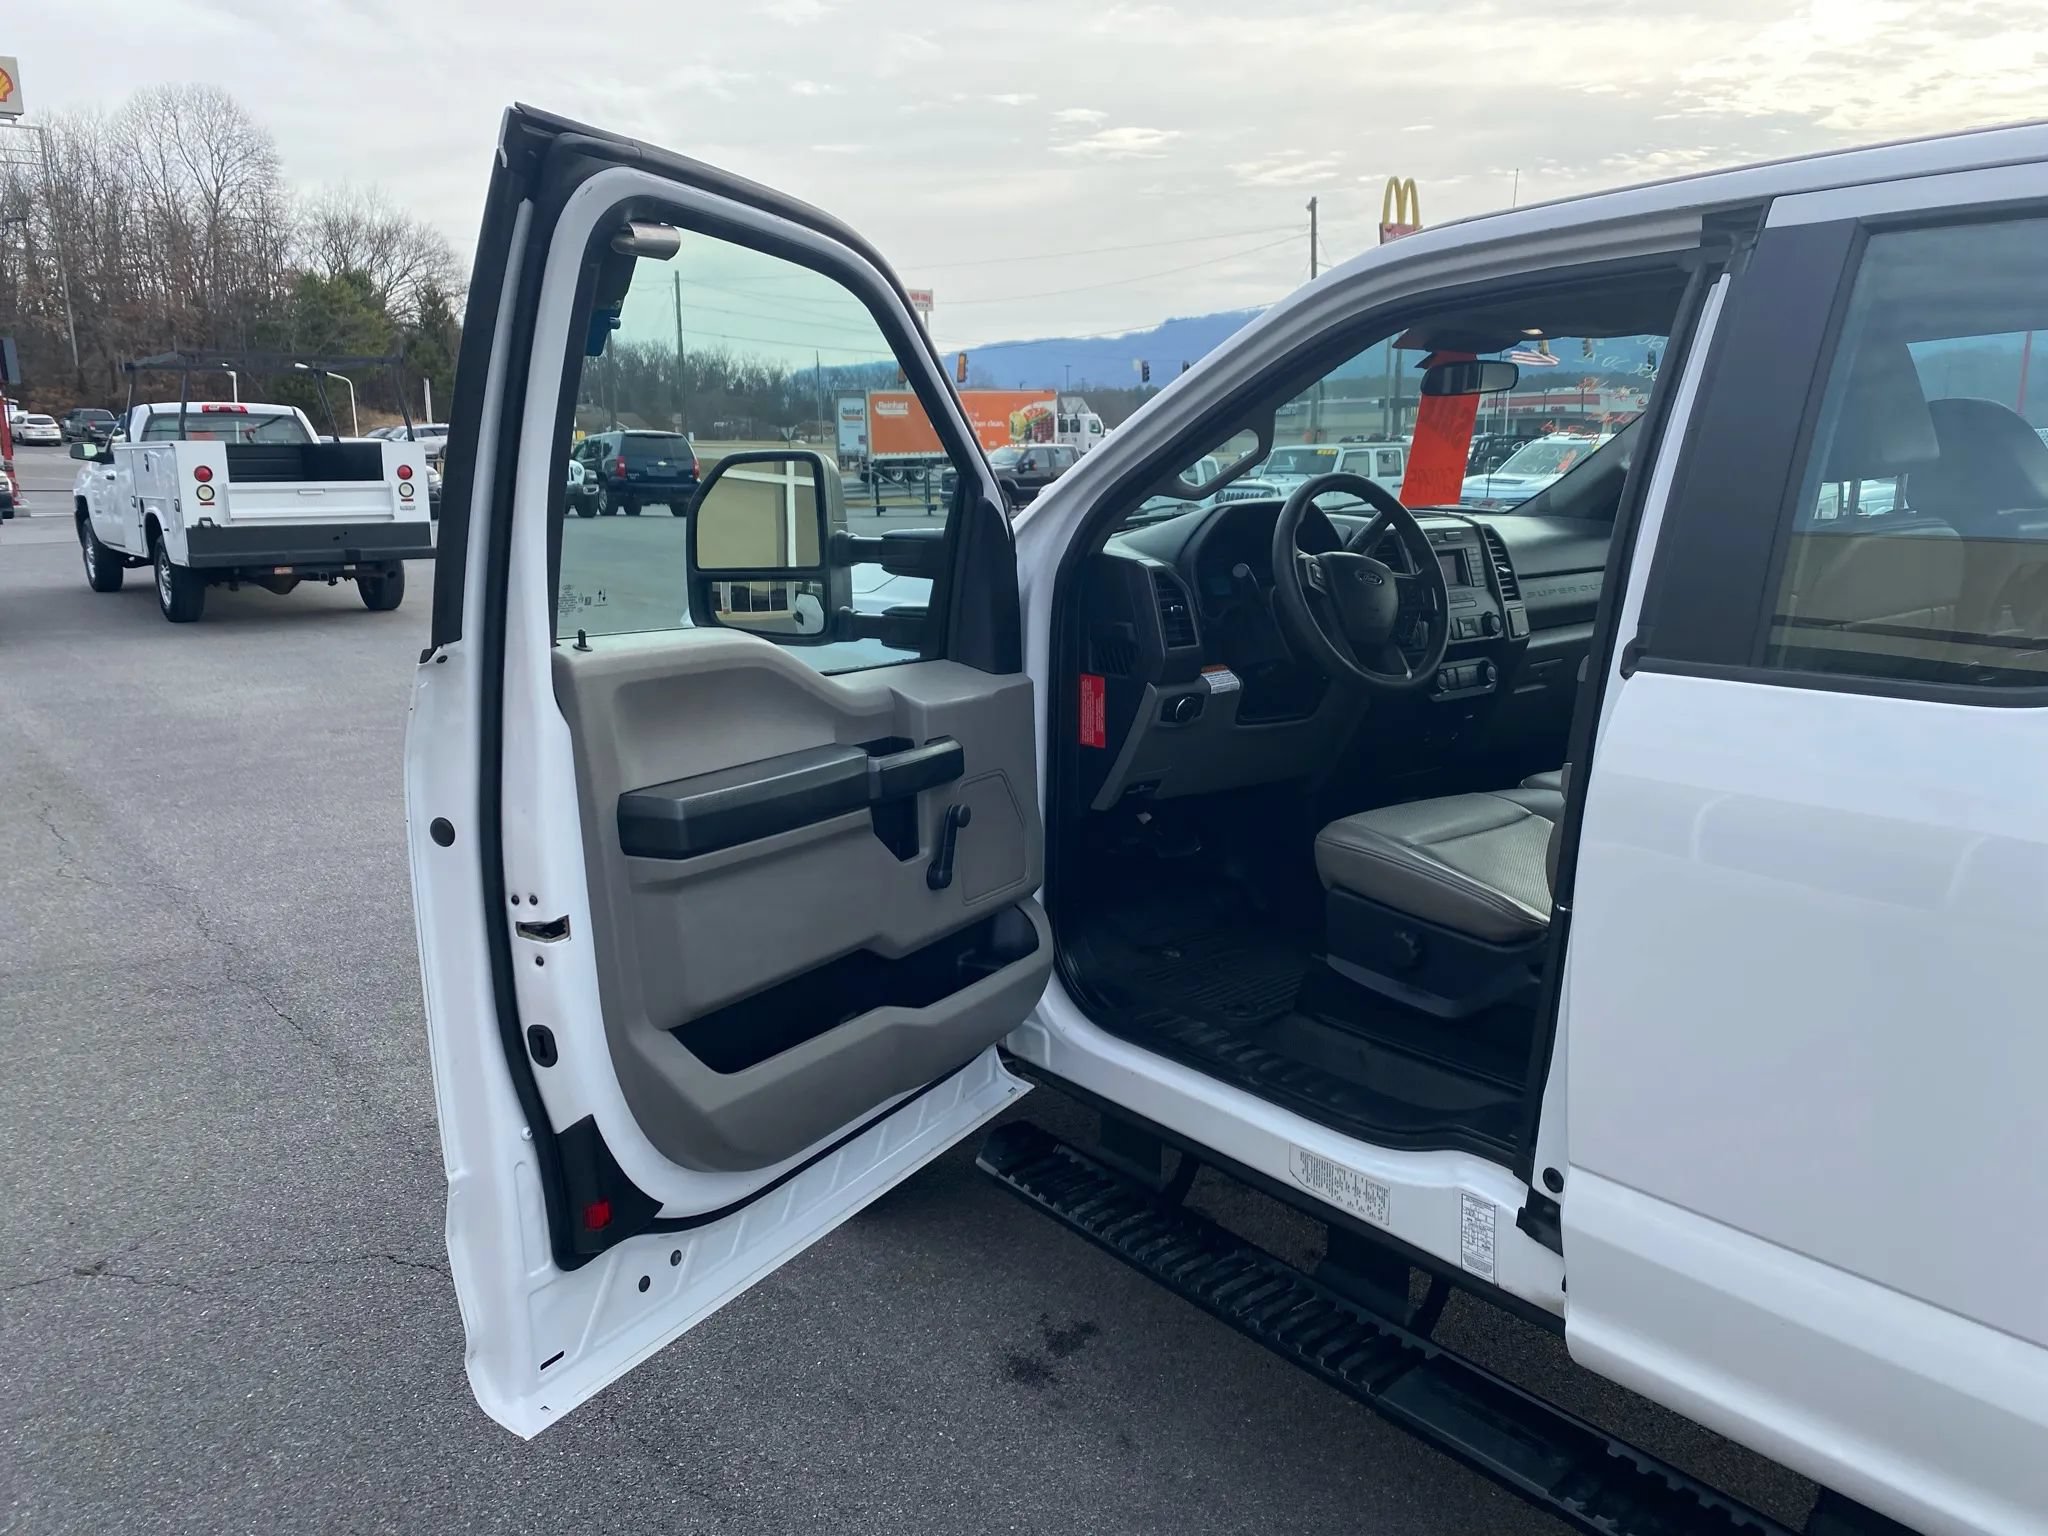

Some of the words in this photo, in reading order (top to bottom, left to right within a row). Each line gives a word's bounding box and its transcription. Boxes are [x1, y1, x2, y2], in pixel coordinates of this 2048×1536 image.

[878, 400, 909, 409] Reinhart
[842, 407, 864, 415] Reinhart
[1526, 586, 1577, 599] SUPER
